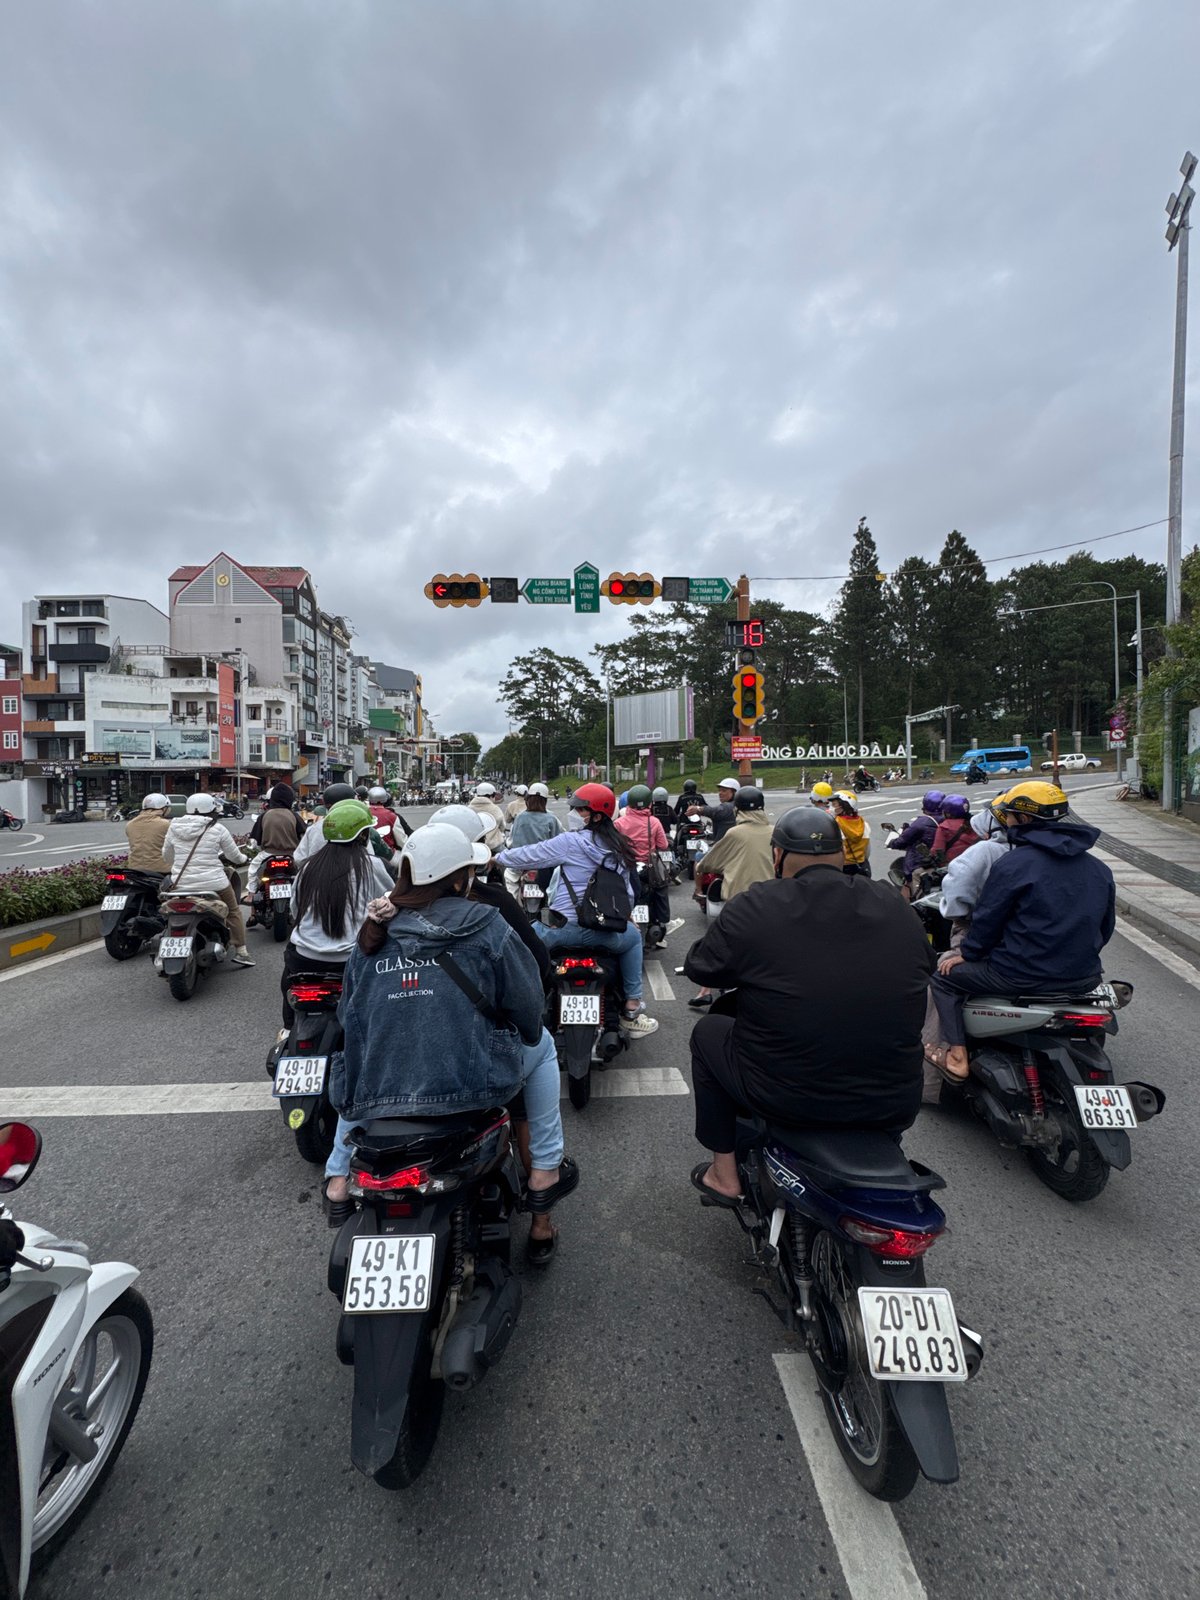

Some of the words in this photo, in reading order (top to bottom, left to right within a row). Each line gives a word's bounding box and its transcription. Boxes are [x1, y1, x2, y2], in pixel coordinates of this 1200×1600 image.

[743, 622, 764, 646] 16
[859, 741, 883, 757] ĐÀ
[566, 996, 593, 1009] 49-B1
[562, 1010, 598, 1023] 833.49
[284, 1059, 319, 1076] 49-D1
[276, 1076, 322, 1093] 794.95
[1085, 1089, 1123, 1106] 49-D1
[1084, 1108, 1135, 1126] 863.91
[361, 1239, 420, 1272] 49-K1
[348, 1274, 426, 1309] 553.58
[875, 1295, 941, 1331] 20-D1
[874, 1335, 959, 1373] 248.83
[33, 1347, 66, 1388] HONDA
